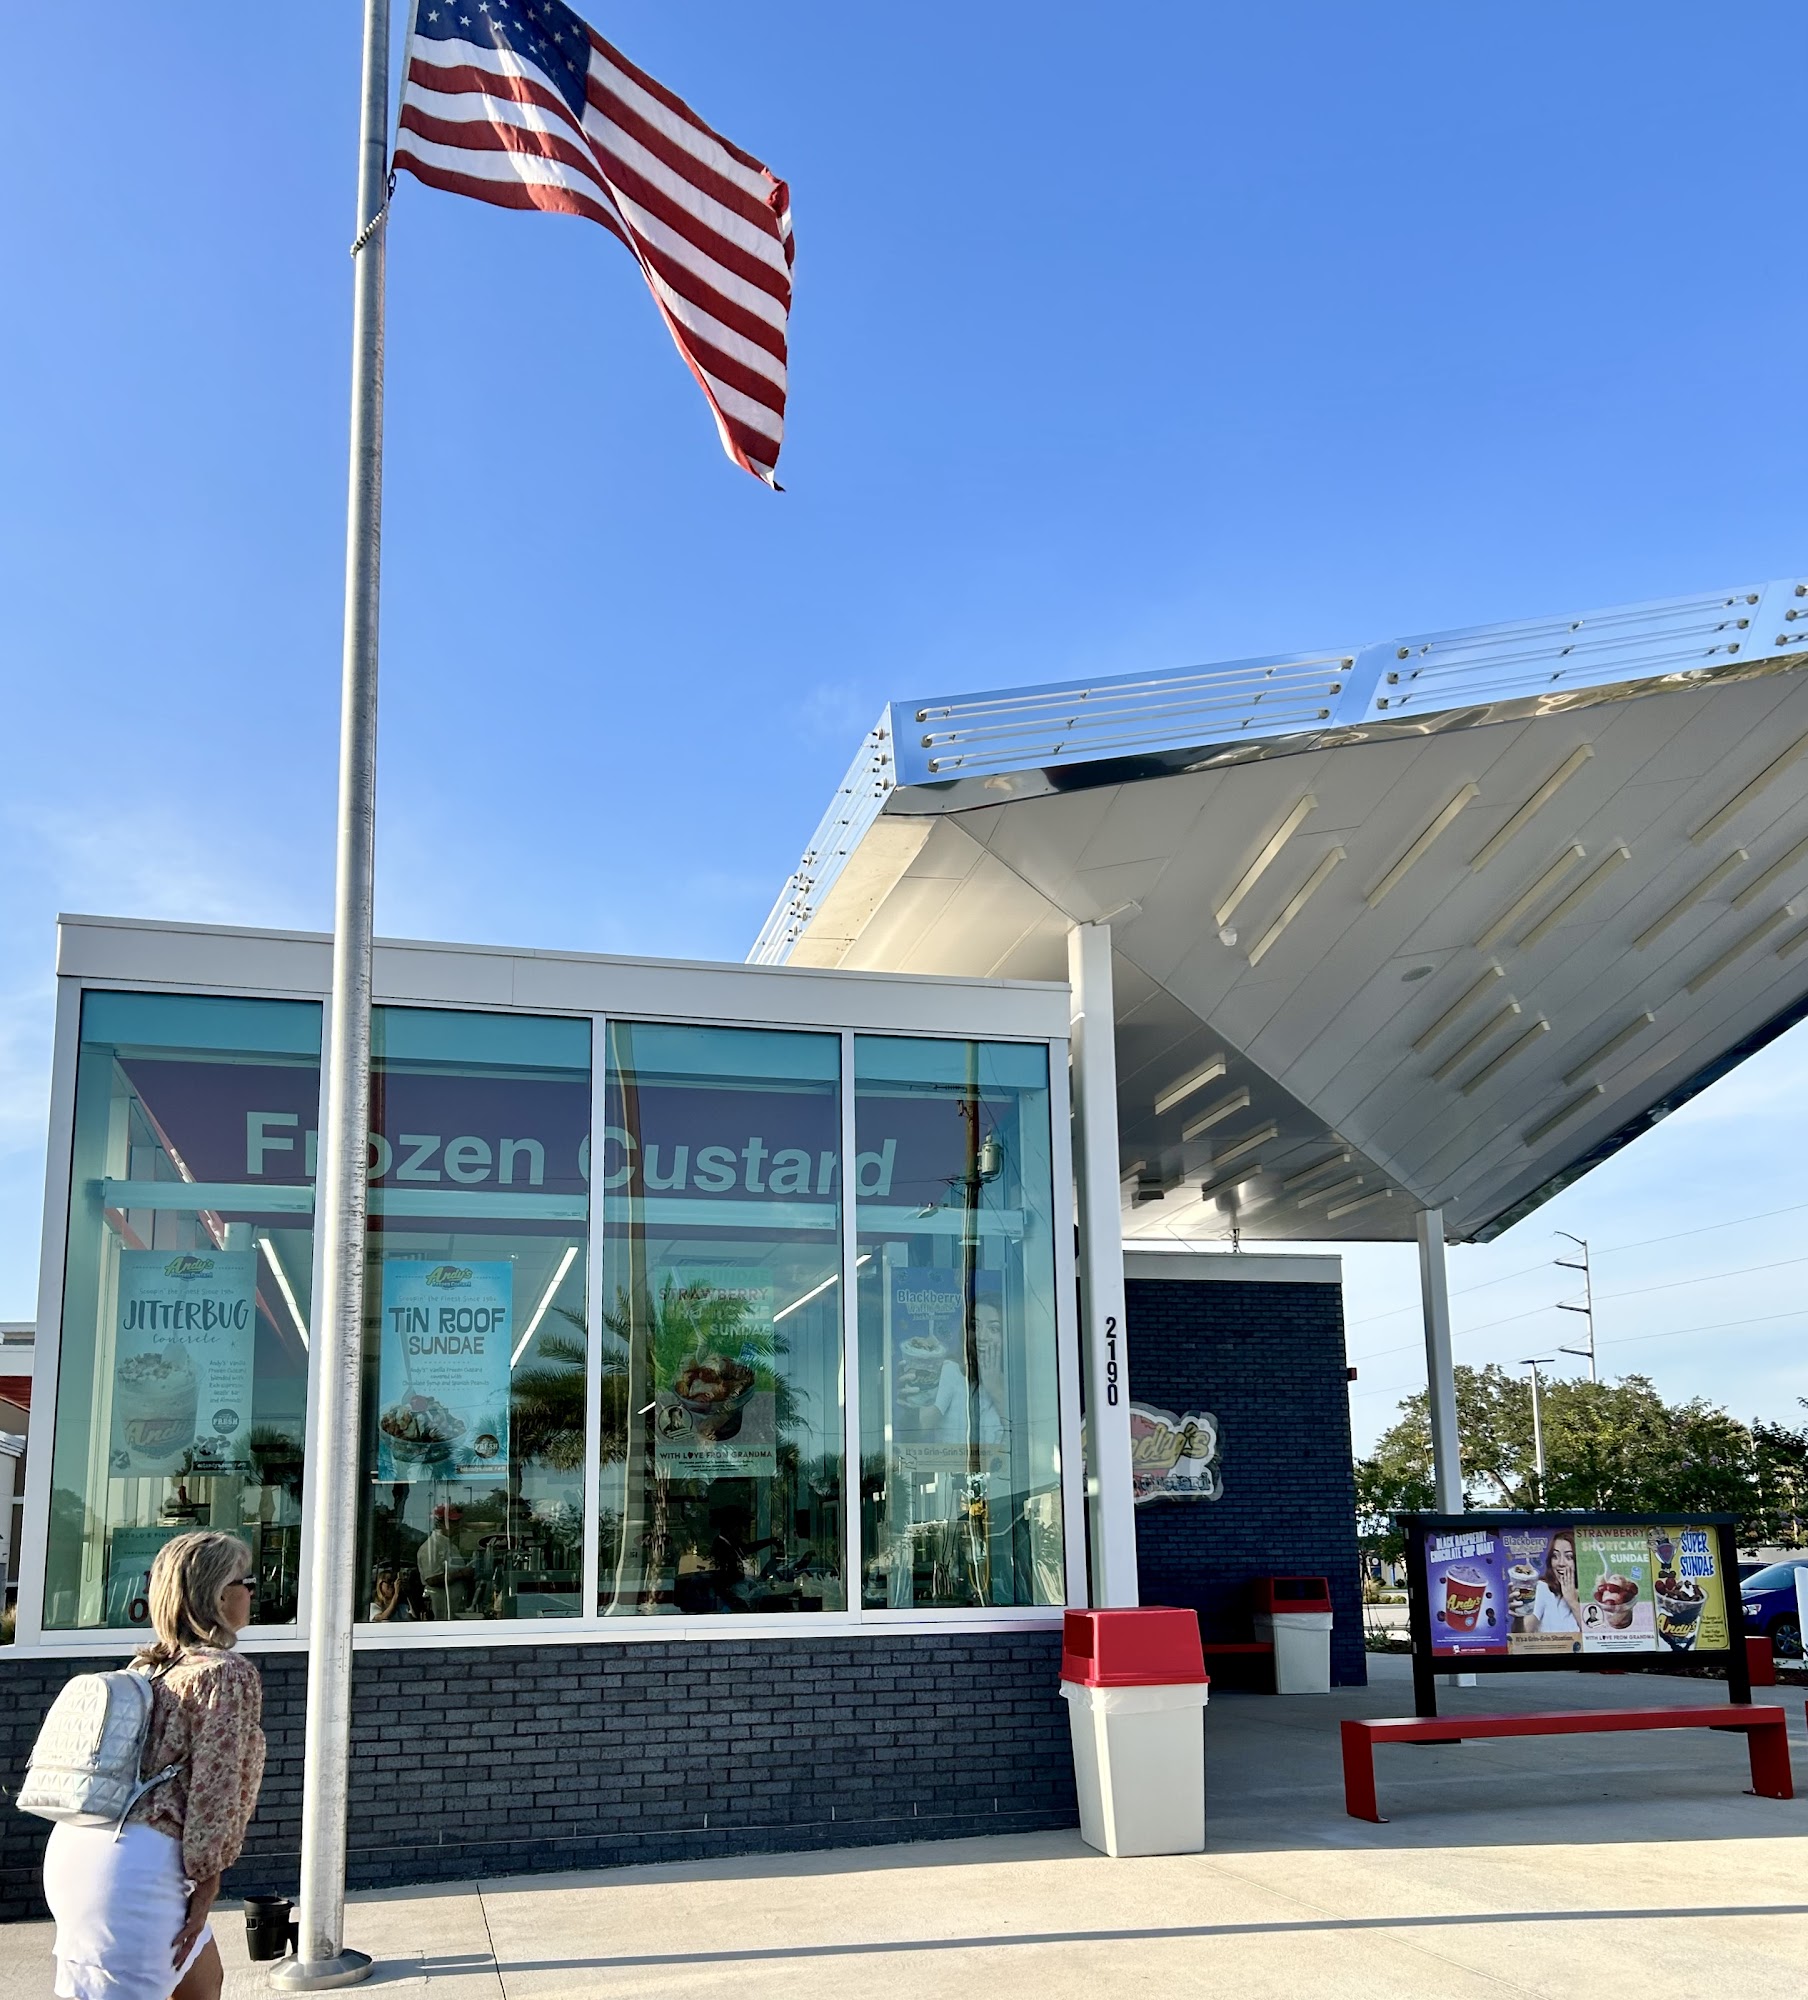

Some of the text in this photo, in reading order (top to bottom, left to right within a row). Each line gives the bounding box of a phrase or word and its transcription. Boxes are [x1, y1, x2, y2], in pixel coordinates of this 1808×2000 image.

[579, 1126, 897, 1197] Custard
[164, 1256, 215, 1277] Andy's
[425, 1266, 473, 1287] Andy's
[462, 1295, 481, 1303] Since
[659, 1287, 769, 1301] STRAWBERRY
[897, 1289, 962, 1308] Blackberry
[123, 1298, 250, 1331] JITTERBUG
[439, 1307, 506, 1334] ROOF
[153, 1333, 220, 1344] Concrete
[709, 1323, 772, 1337] SUNDAE
[409, 1336, 485, 1356] SUNDAE
[1105, 1316, 1119, 1406] 2190
[213, 1417, 238, 1426] FRESH
[924, 1447, 958, 1456] Grin-Grin
[1131, 1421, 1211, 1470] ndy's
[660, 1452, 680, 1460] WITH
[730, 1450, 772, 1459] GRANDMA
[154, 1531, 177, 1539] FINES
[1576, 1528, 1645, 1538] STRAWBERRY
[1503, 1536, 1547, 1549] Blackberry
[1582, 1540, 1648, 1552] SHORTCAKE
[1680, 1532, 1709, 1553] SUPER
[1610, 1553, 1649, 1563] SUNDAE
[1679, 1555, 1715, 1577] SUNDAE
[1447, 1594, 1481, 1611] Andy's
[1657, 1613, 1697, 1637] Andy's
